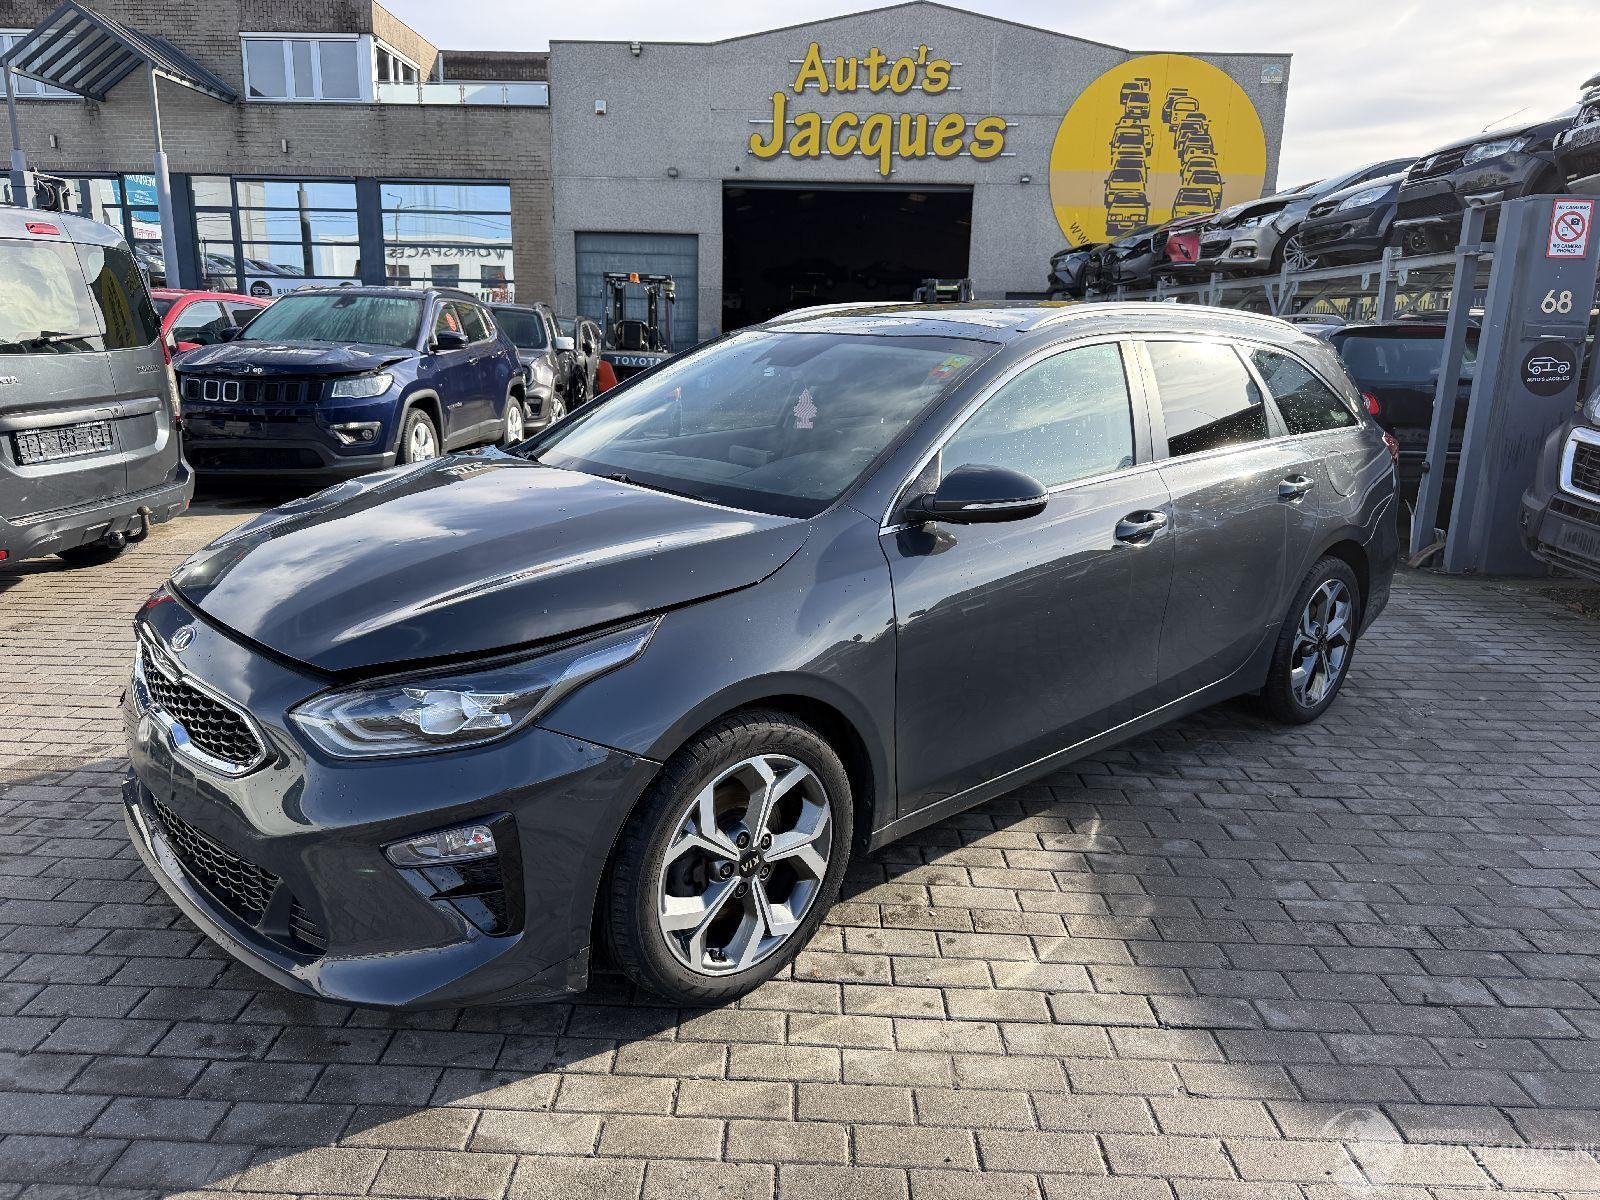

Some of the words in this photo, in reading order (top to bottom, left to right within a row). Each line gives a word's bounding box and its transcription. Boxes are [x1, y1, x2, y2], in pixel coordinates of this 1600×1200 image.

[793, 42, 952, 95] Auto's
[750, 91, 1007, 177] Jacques
[1541, 289, 1572, 314] 68
[244, 366, 263, 375] Jep
[614, 356, 662, 366] TOYOTA
[740, 854, 760, 872] KIA
